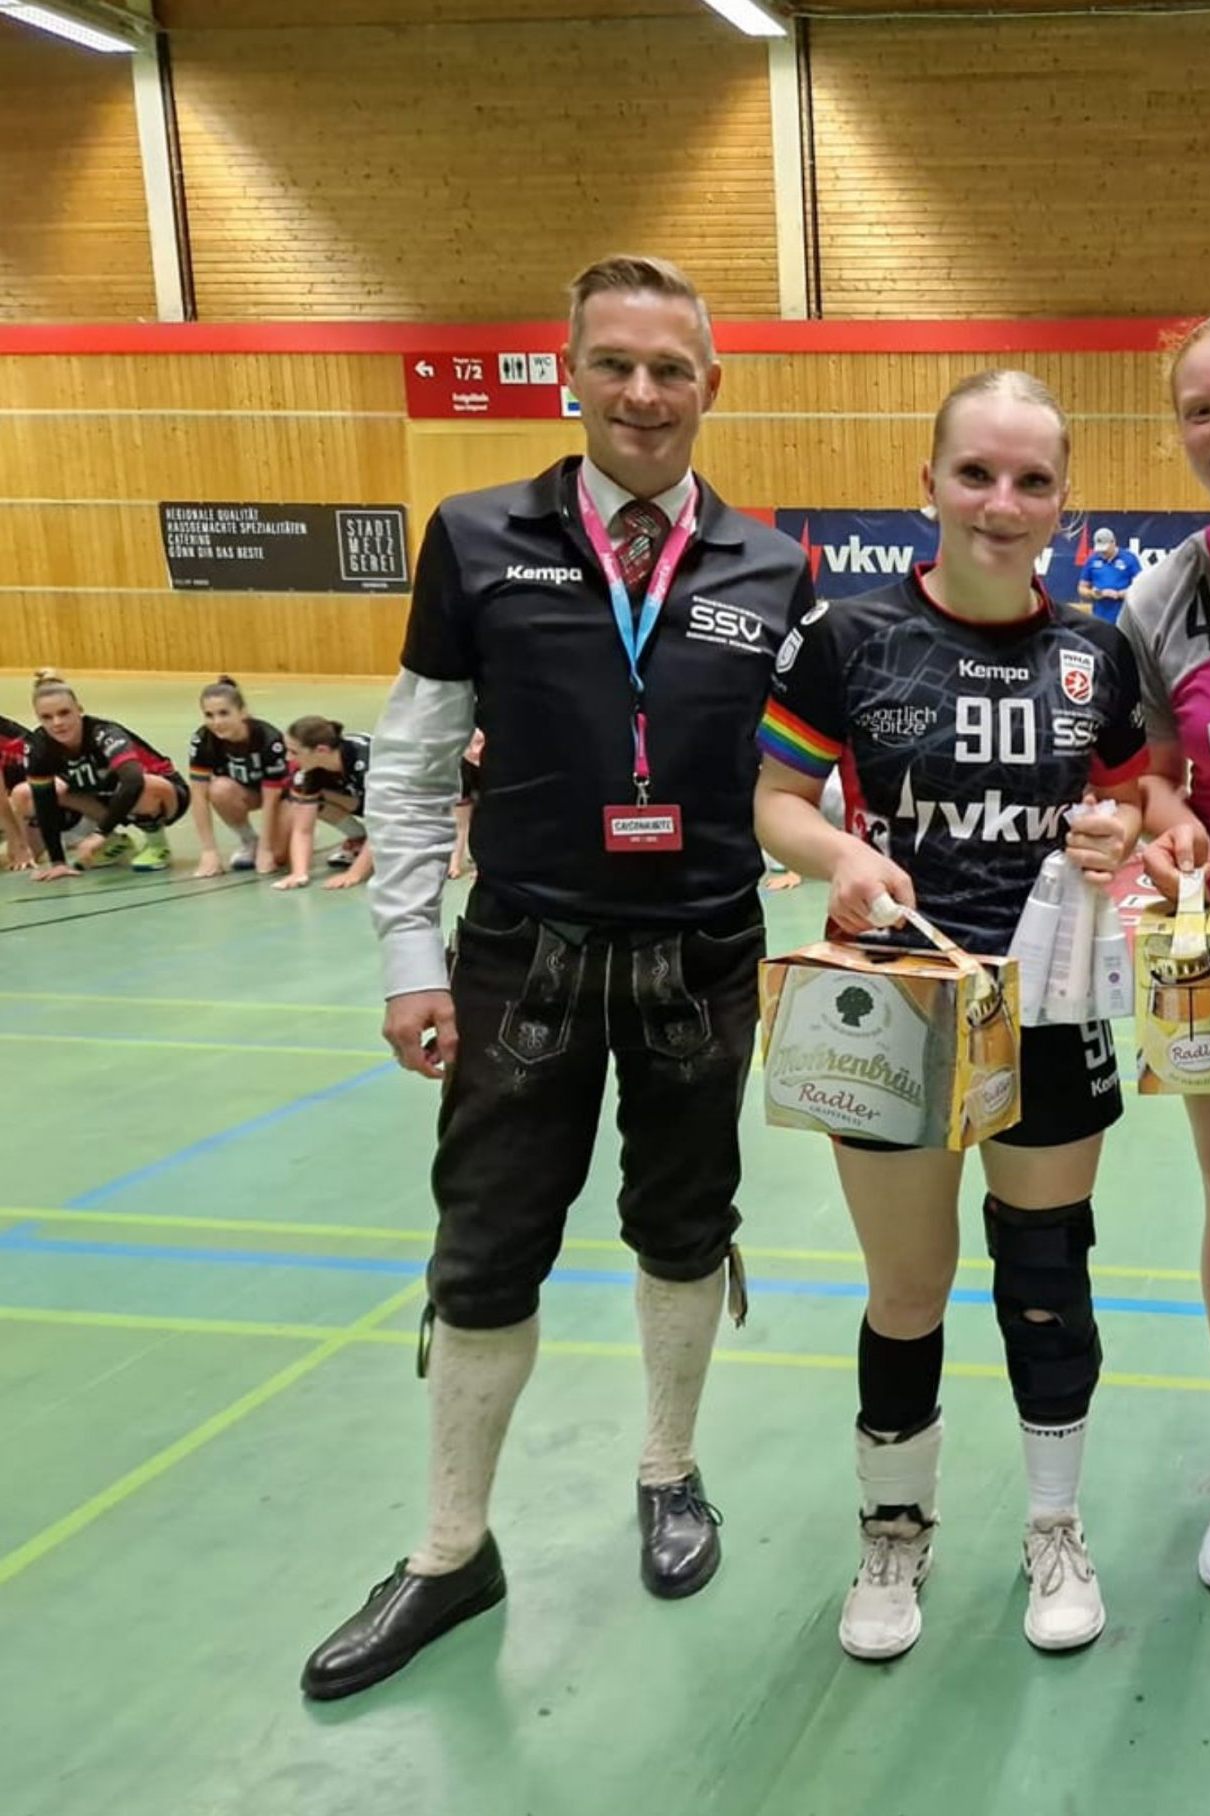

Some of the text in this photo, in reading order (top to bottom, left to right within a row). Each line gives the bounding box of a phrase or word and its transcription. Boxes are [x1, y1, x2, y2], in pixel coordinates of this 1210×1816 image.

[534, 357, 552, 366] WC
[454, 365, 483, 380] 1/2
[166, 507, 258, 521] REGIONALE QUALITÄT
[167, 520, 307, 534] HAUSGEMACHTE SPEZIALITÄTEN
[346, 518, 391, 537] STADT
[168, 533, 210, 545] CATERING
[348, 536, 394, 555] METZ
[216, 546, 234, 558] DAS
[825, 535, 913, 573] vkw
[506, 565, 583, 584] Kempa
[690, 605, 762, 642] SSV
[958, 660, 1030, 684] Kempa
[954, 697, 1037, 764] 90
[69, 766, 96, 787] 77
[938, 789, 1070, 842] vkw
[798, 1082, 881, 1120] Radler
